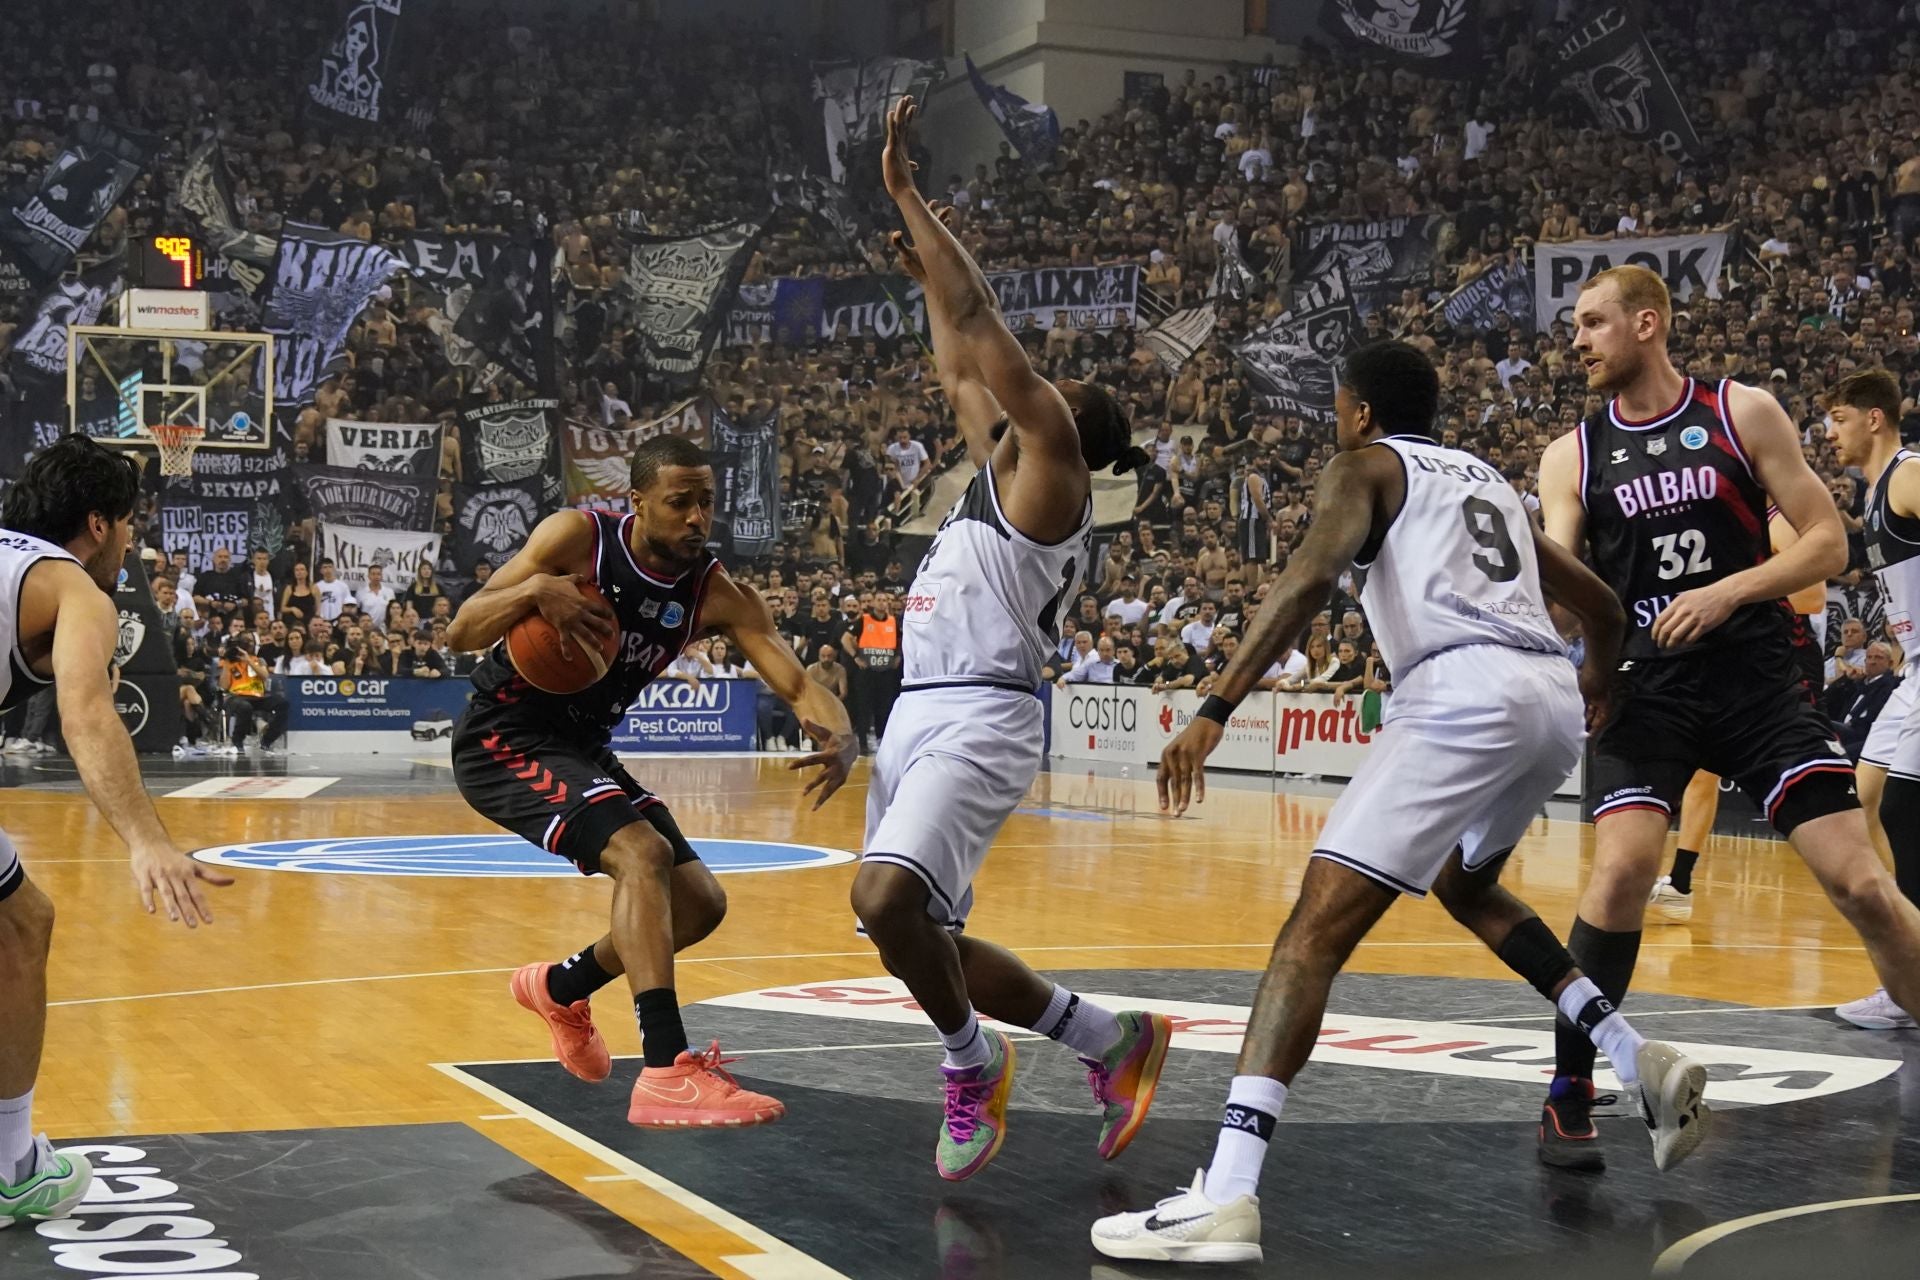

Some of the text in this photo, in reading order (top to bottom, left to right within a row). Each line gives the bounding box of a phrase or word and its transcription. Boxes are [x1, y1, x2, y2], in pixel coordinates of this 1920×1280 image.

[155, 237, 191, 256] 9:02
[137, 305, 199, 316] winmasters
[340, 426, 434, 449] VERIA
[1614, 466, 1717, 519] BILBAO
[204, 513, 247, 535] GEGS
[1462, 494, 1522, 583] 9
[1651, 529, 1713, 580] 32
[870, 655, 890, 666] 069
[301, 680, 389, 696] eco car
[302, 707, 325, 717] 100%
[1069, 694, 1137, 733] casta
[629, 717, 723, 734] Pest Control
[1097, 735, 1135, 752] advisors
[1612, 786, 1653, 799] CORREO
[1223, 1107, 1260, 1134] GSA
